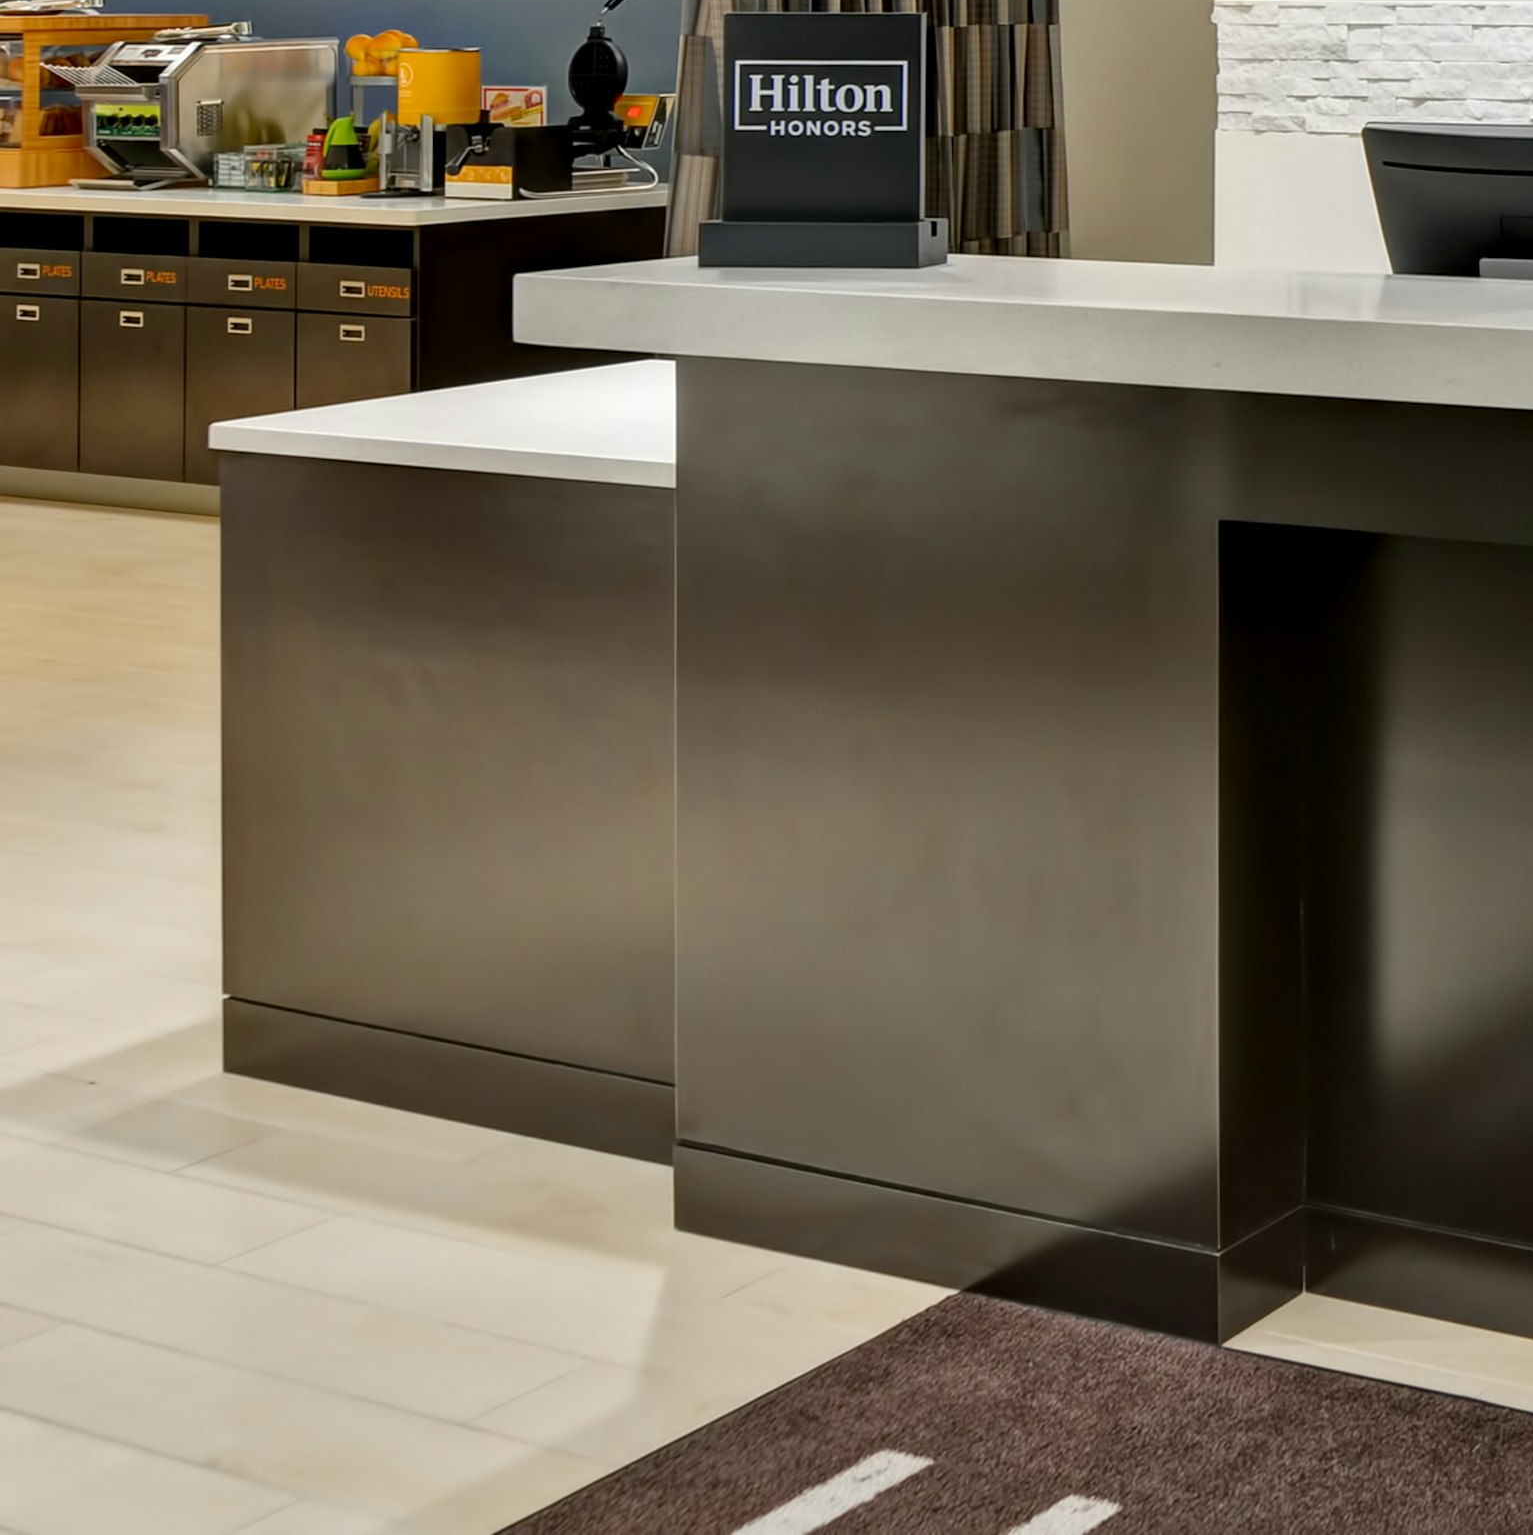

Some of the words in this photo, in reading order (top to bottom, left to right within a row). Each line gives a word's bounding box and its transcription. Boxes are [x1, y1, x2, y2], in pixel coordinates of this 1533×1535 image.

[748, 74, 894, 113] Hilton
[769, 119, 873, 137] HONORS
[41, 265, 73, 278] PLATES
[145, 271, 177, 284] PLATES
[253, 277, 286, 290] PLATES
[366, 284, 410, 300] UTENSILS
